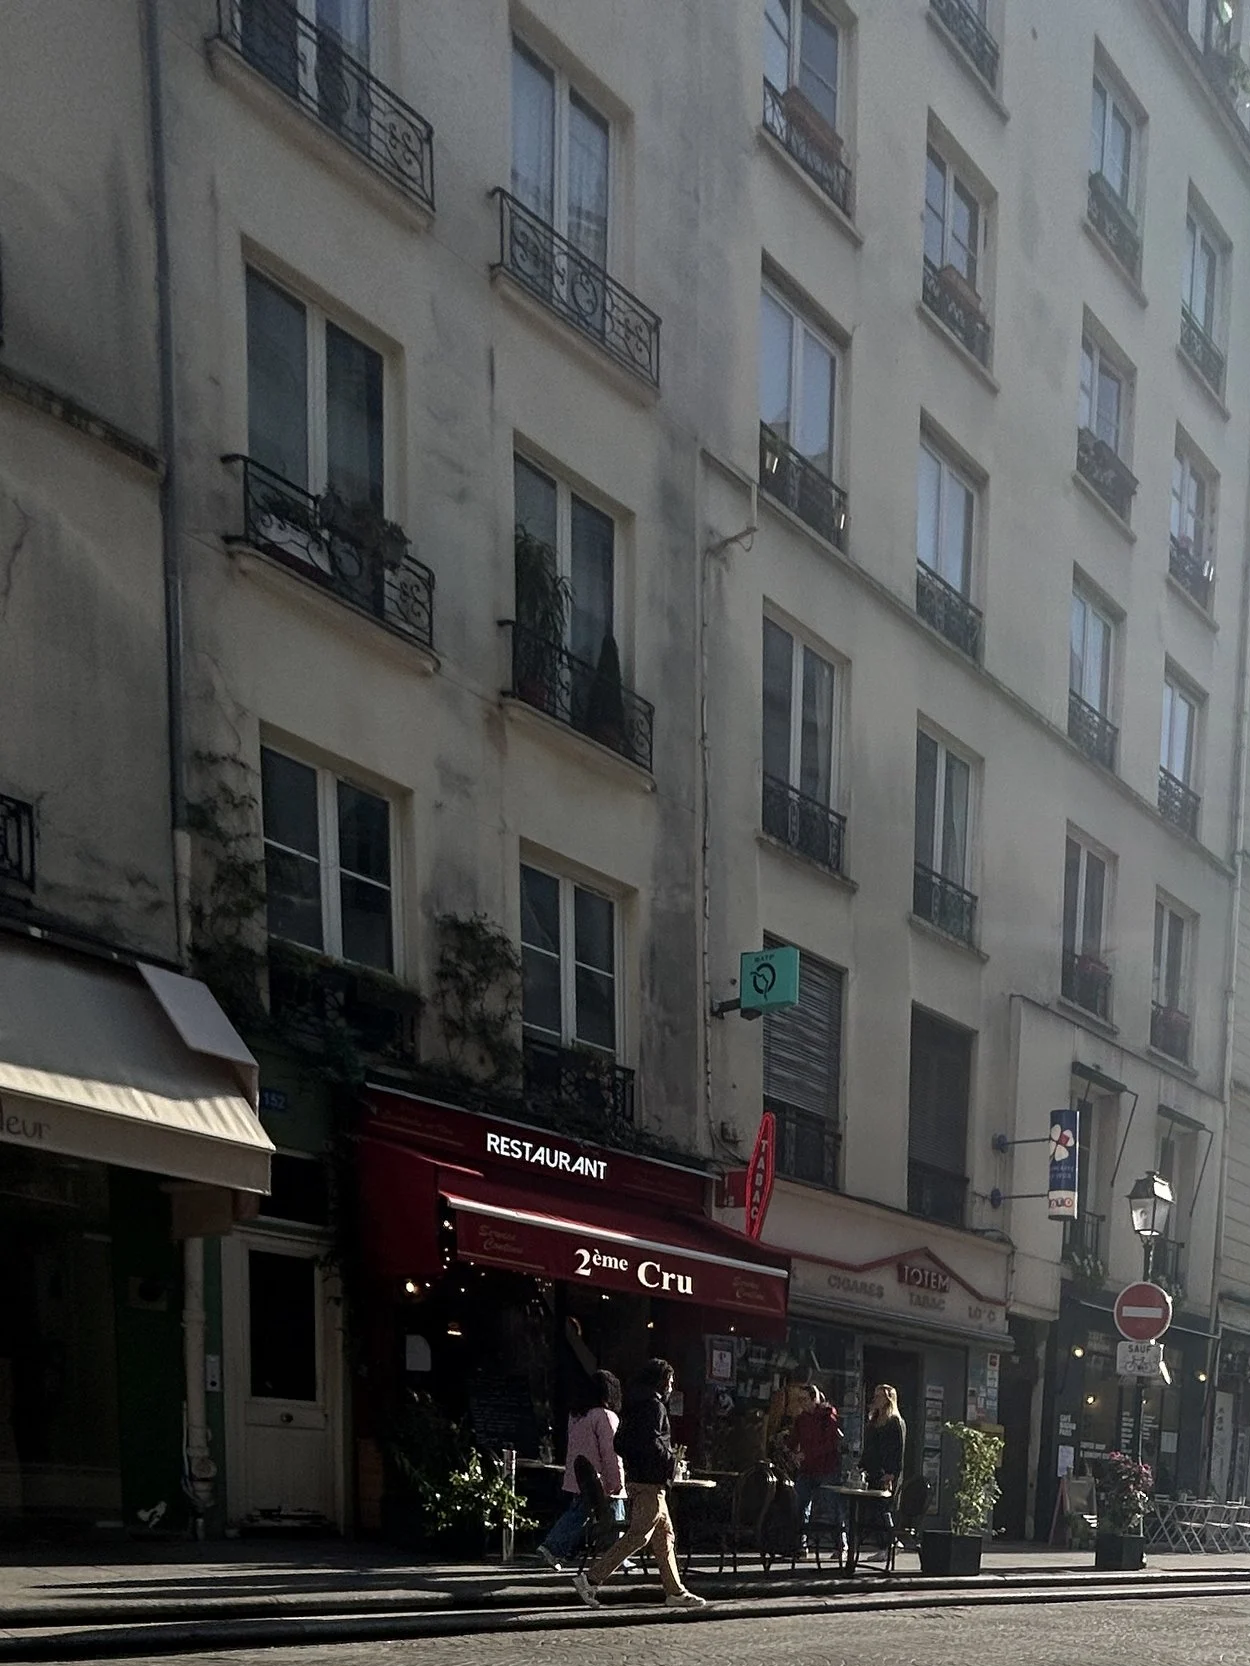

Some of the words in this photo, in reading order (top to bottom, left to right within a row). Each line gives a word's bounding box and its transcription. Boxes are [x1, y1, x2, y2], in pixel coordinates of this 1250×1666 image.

[264, 1091, 286, 1109] 152
[486, 1132, 608, 1180] RESTAURANT
[751, 1139, 769, 1220] TABAC
[574, 1248, 629, 1277] 2ème
[637, 1260, 694, 1296] Cru
[904, 1265, 951, 1291] TOTEM
[827, 1274, 885, 1300] CIGARES
[908, 1291, 946, 1311] TABAC
[1127, 1344, 1152, 1353] SAUF
